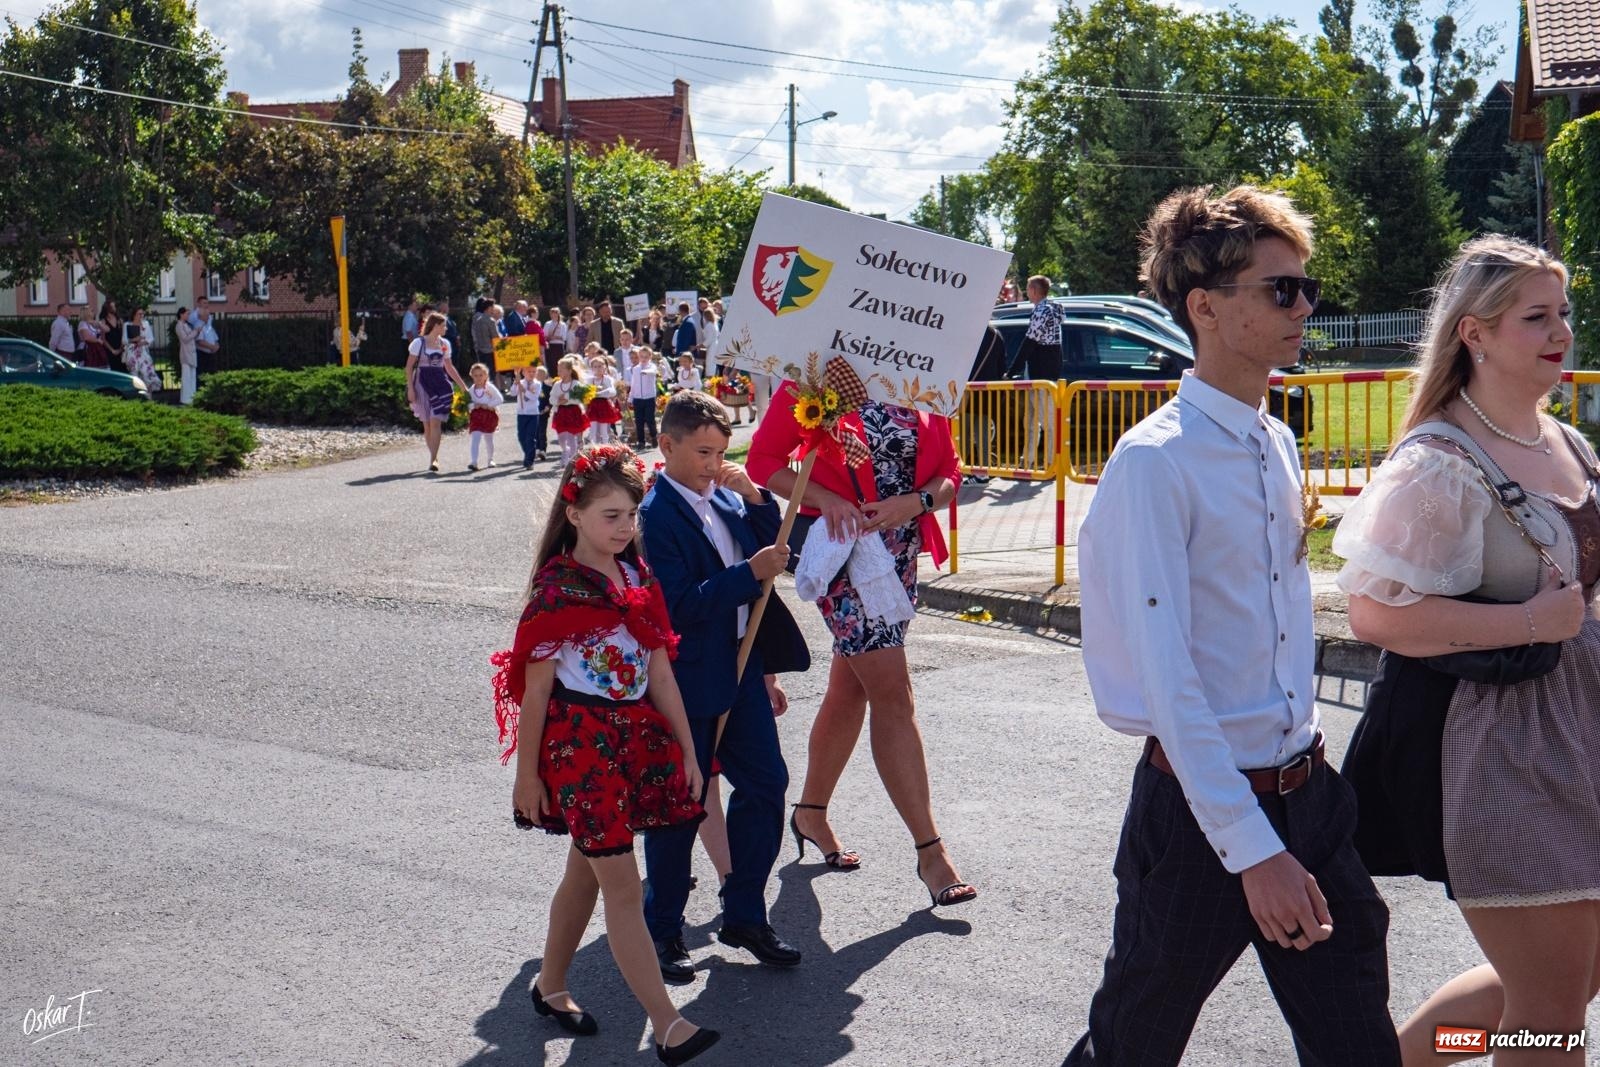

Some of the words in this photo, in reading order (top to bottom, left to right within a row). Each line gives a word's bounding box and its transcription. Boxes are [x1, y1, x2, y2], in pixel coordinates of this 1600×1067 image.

[856, 244, 967, 289] Sołectwo
[848, 288, 945, 330] Zawada
[829, 329, 935, 373] Książęca
